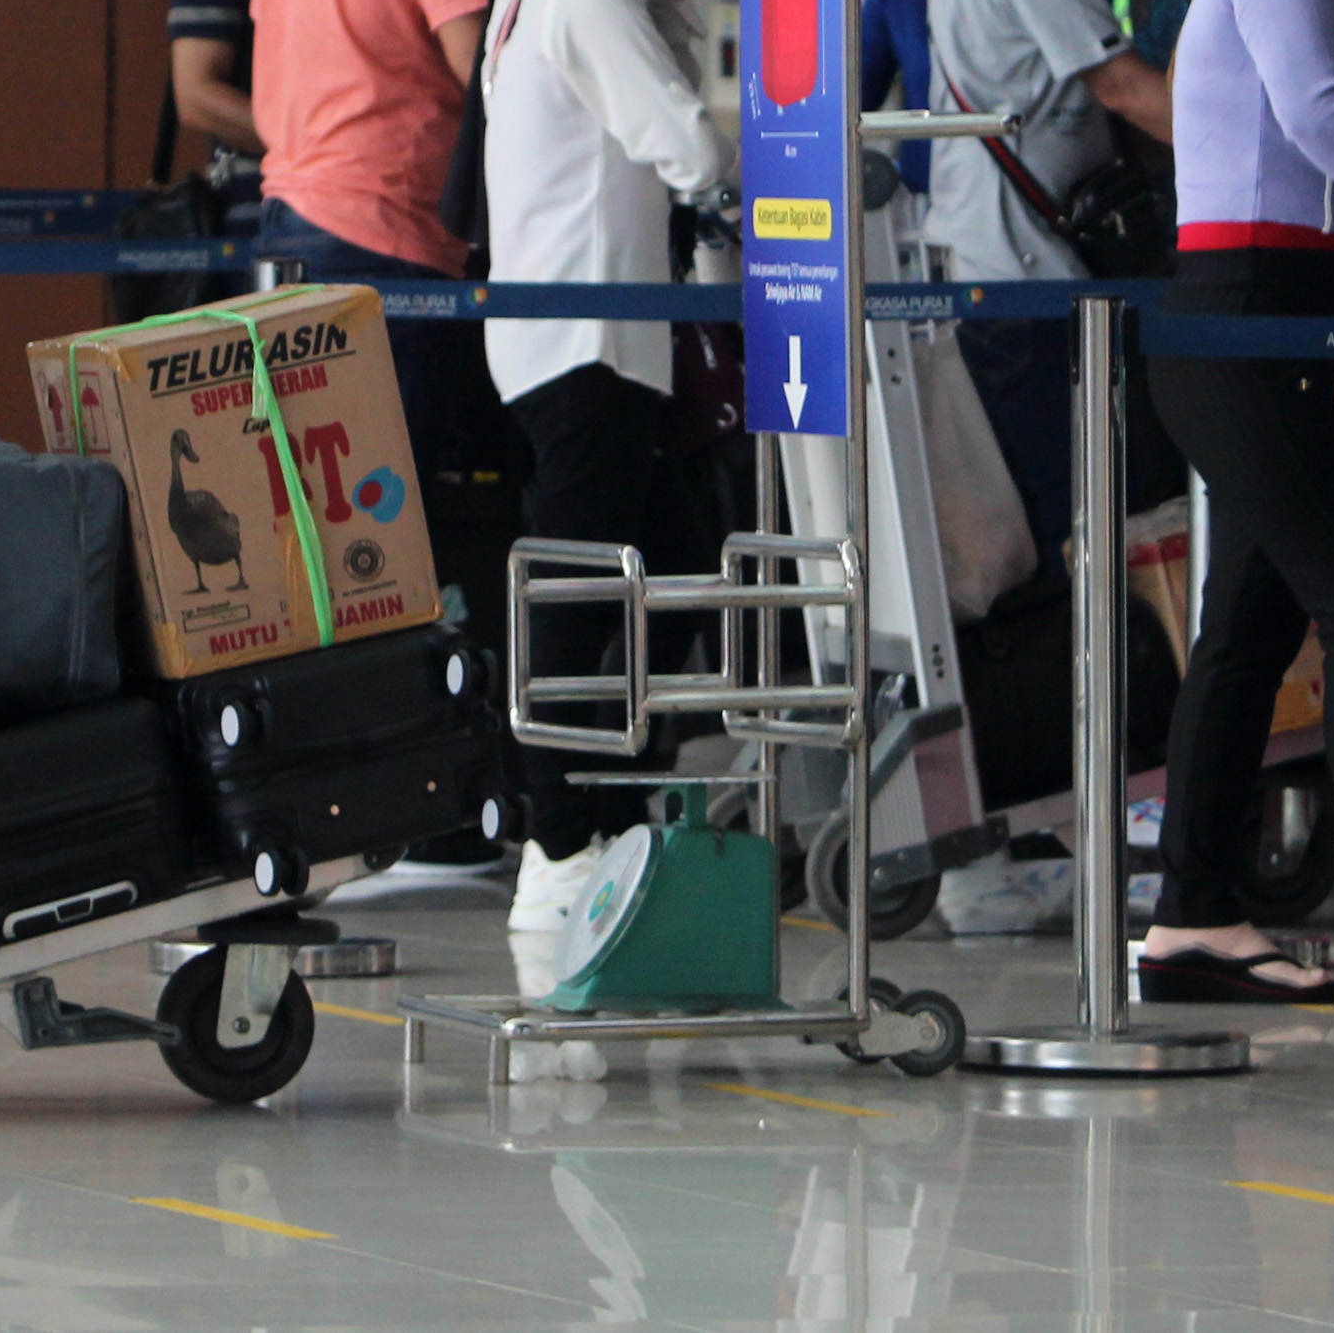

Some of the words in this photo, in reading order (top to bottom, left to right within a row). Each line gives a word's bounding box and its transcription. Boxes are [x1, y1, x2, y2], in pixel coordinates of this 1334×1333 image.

[147, 339, 255, 393] TELUR
[265, 322, 348, 368] ASIN
[190, 381, 253, 417] SUPER
[209, 621, 279, 656] MUTU
